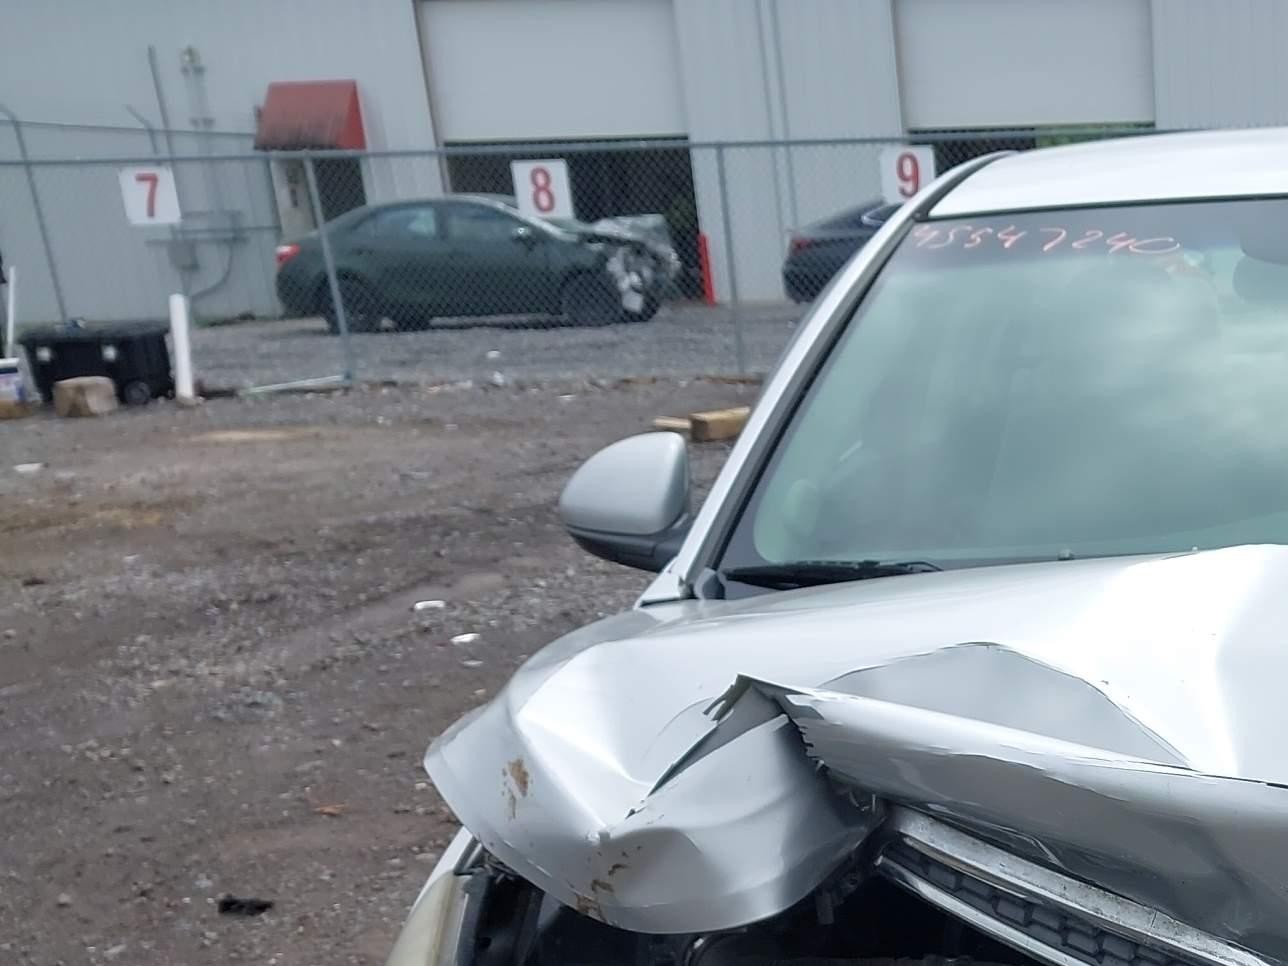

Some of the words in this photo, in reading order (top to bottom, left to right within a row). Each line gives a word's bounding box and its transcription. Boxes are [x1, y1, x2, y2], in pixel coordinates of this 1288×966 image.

[135, 173, 159, 219] 7
[530, 167, 555, 213] 8
[896, 151, 919, 198] 9
